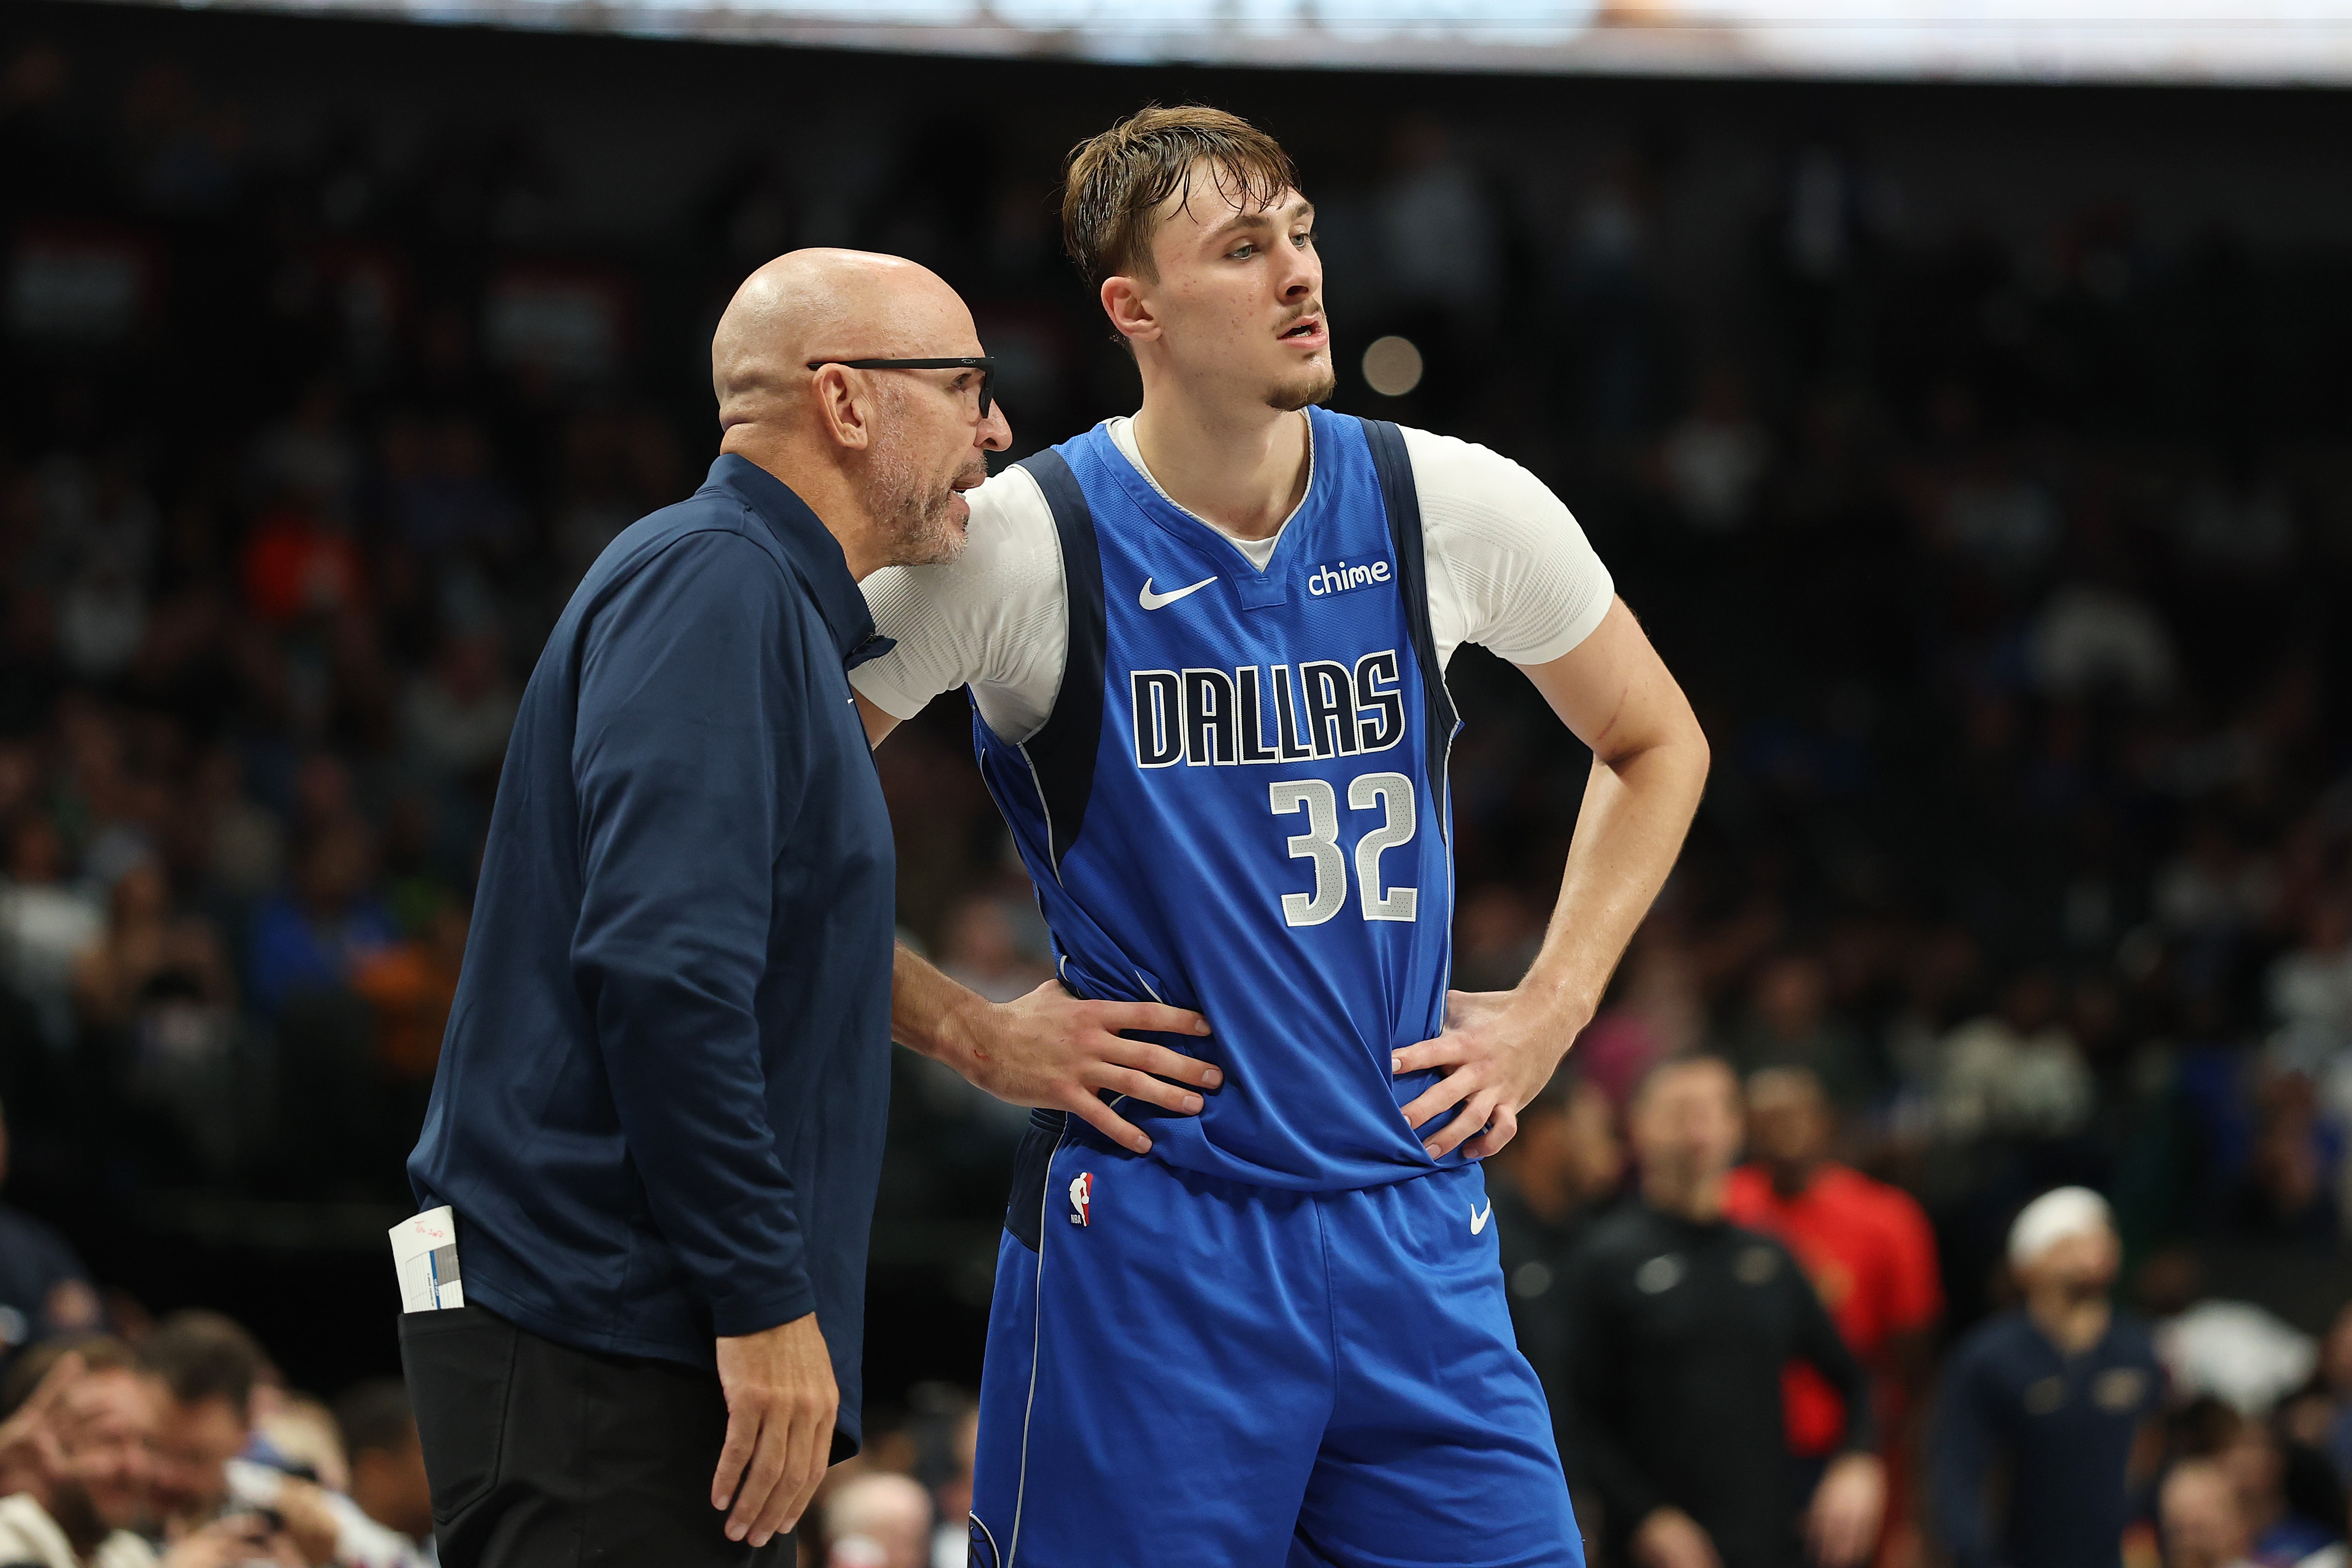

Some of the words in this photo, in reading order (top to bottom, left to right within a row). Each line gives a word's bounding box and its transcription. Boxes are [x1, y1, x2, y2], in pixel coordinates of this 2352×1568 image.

[1308, 561, 1391, 596] chime
[1131, 650, 1405, 768] DALLAS
[1269, 772, 1417, 927] 32
[1071, 1214, 1081, 1224] NBA
